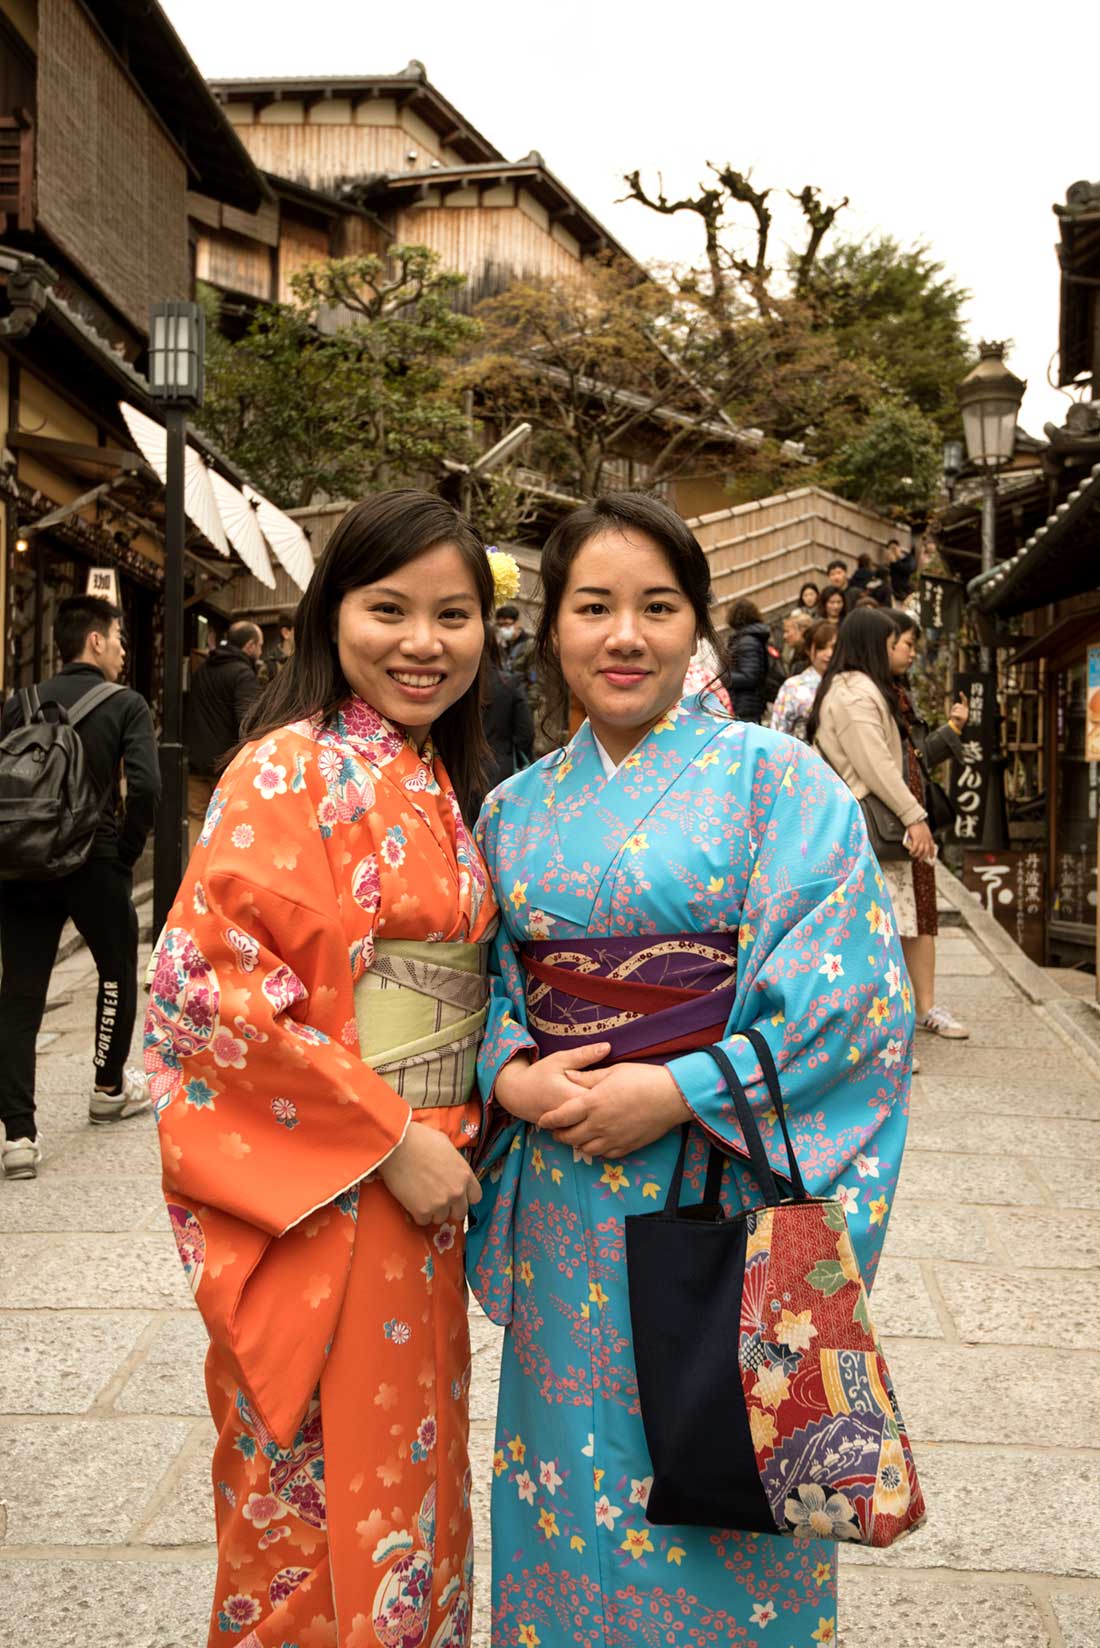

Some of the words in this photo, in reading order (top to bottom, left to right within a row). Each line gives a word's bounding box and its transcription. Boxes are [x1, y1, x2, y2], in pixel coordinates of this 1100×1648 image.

[954, 741, 983, 838] きんつば
[1025, 853, 1040, 914] 丹波黒の
[94, 980, 119, 1068] SPORTSWEAR
